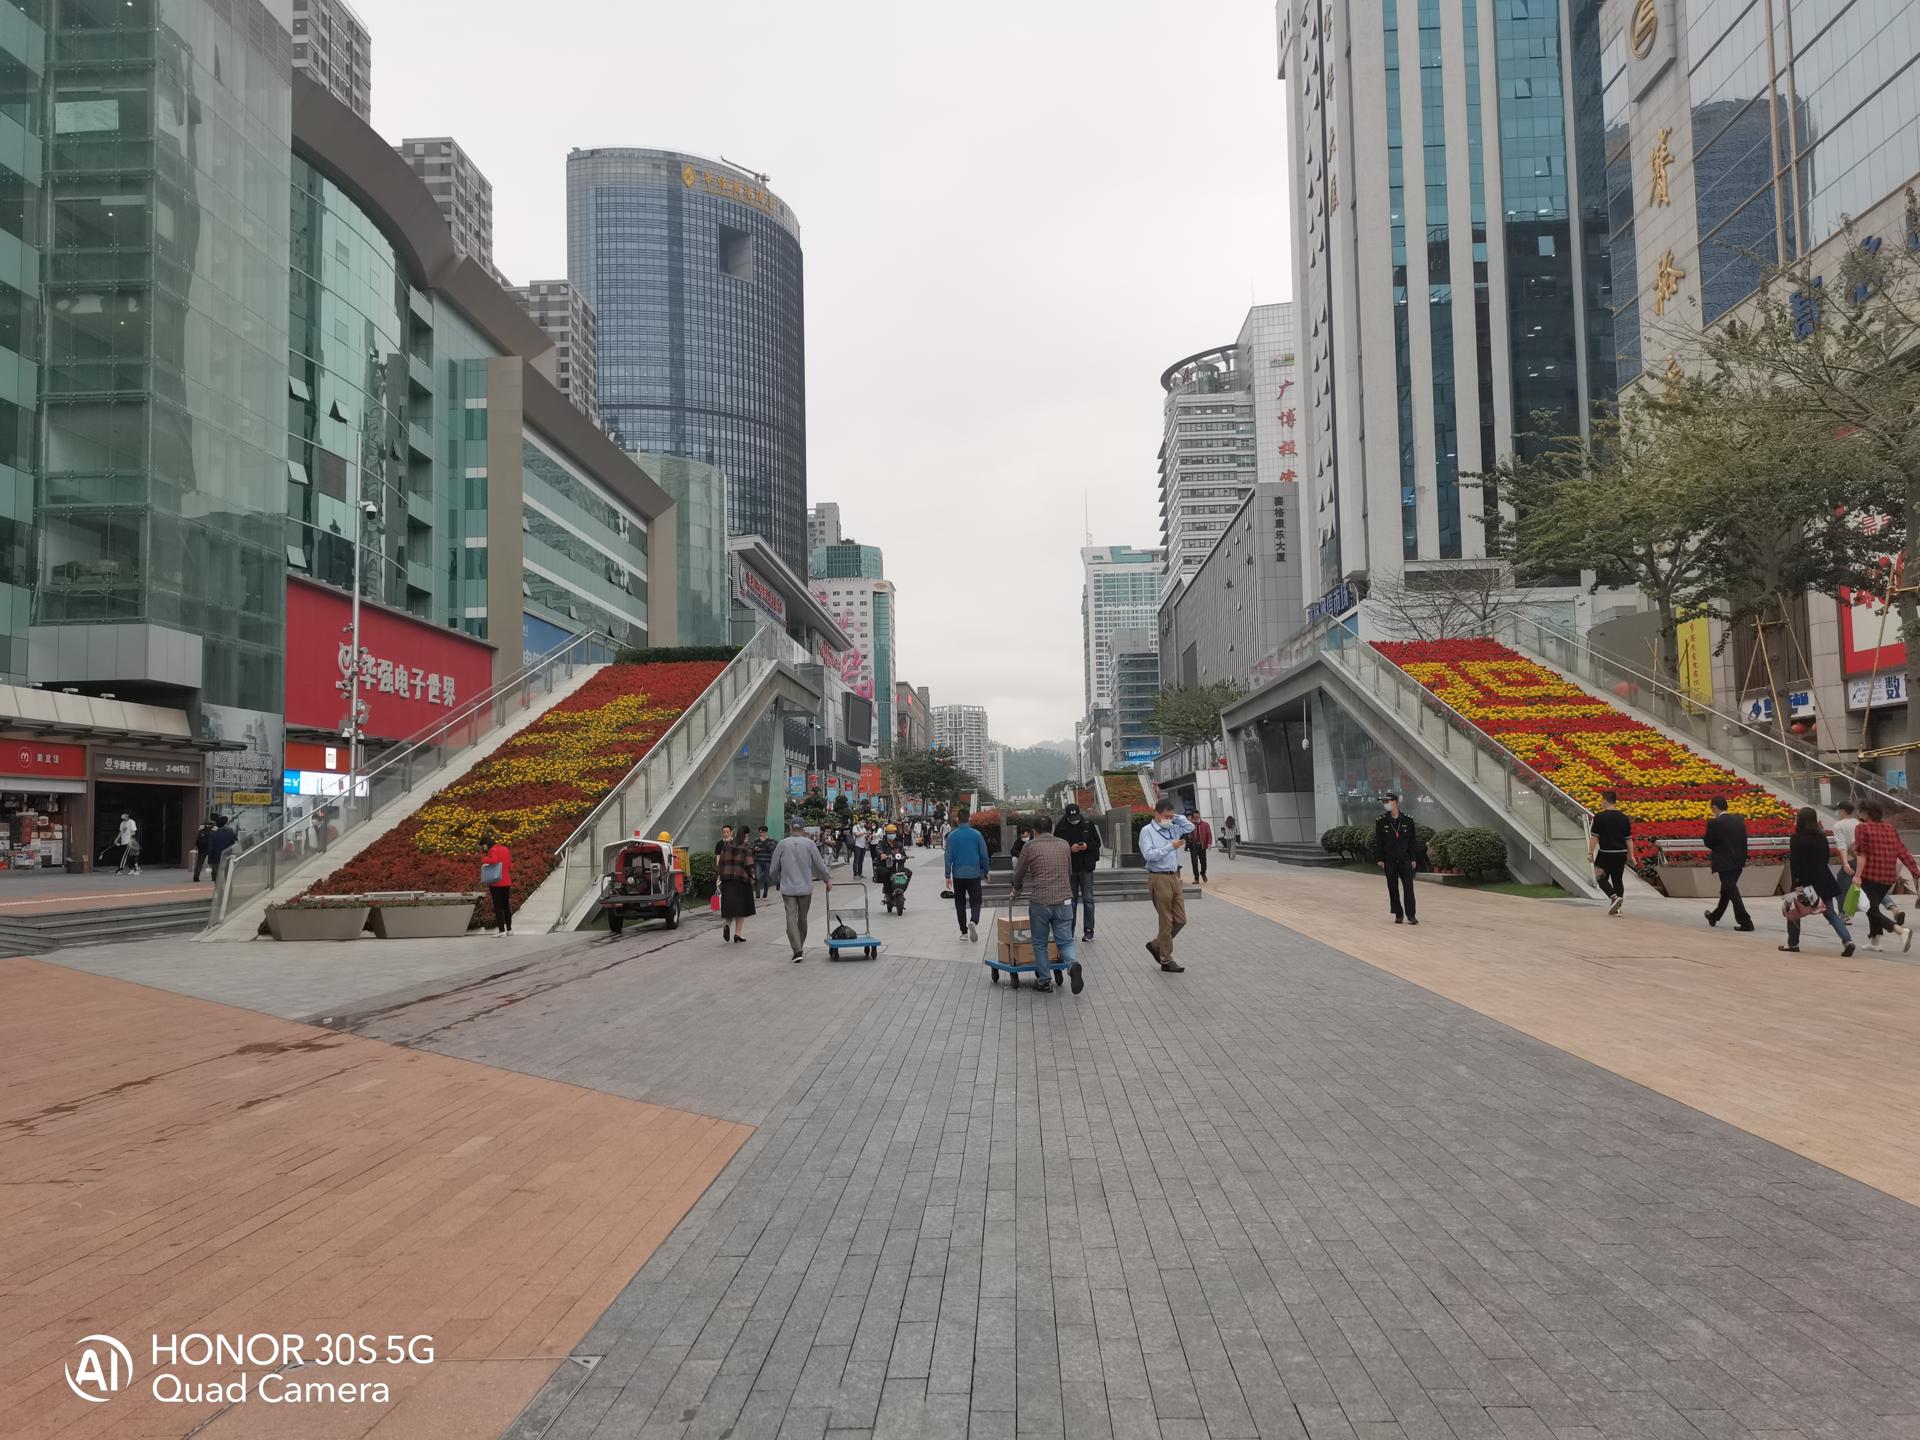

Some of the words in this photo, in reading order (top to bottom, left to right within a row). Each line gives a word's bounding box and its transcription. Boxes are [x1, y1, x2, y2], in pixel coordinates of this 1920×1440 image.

[360, 654, 456, 707] 华强电子世界
